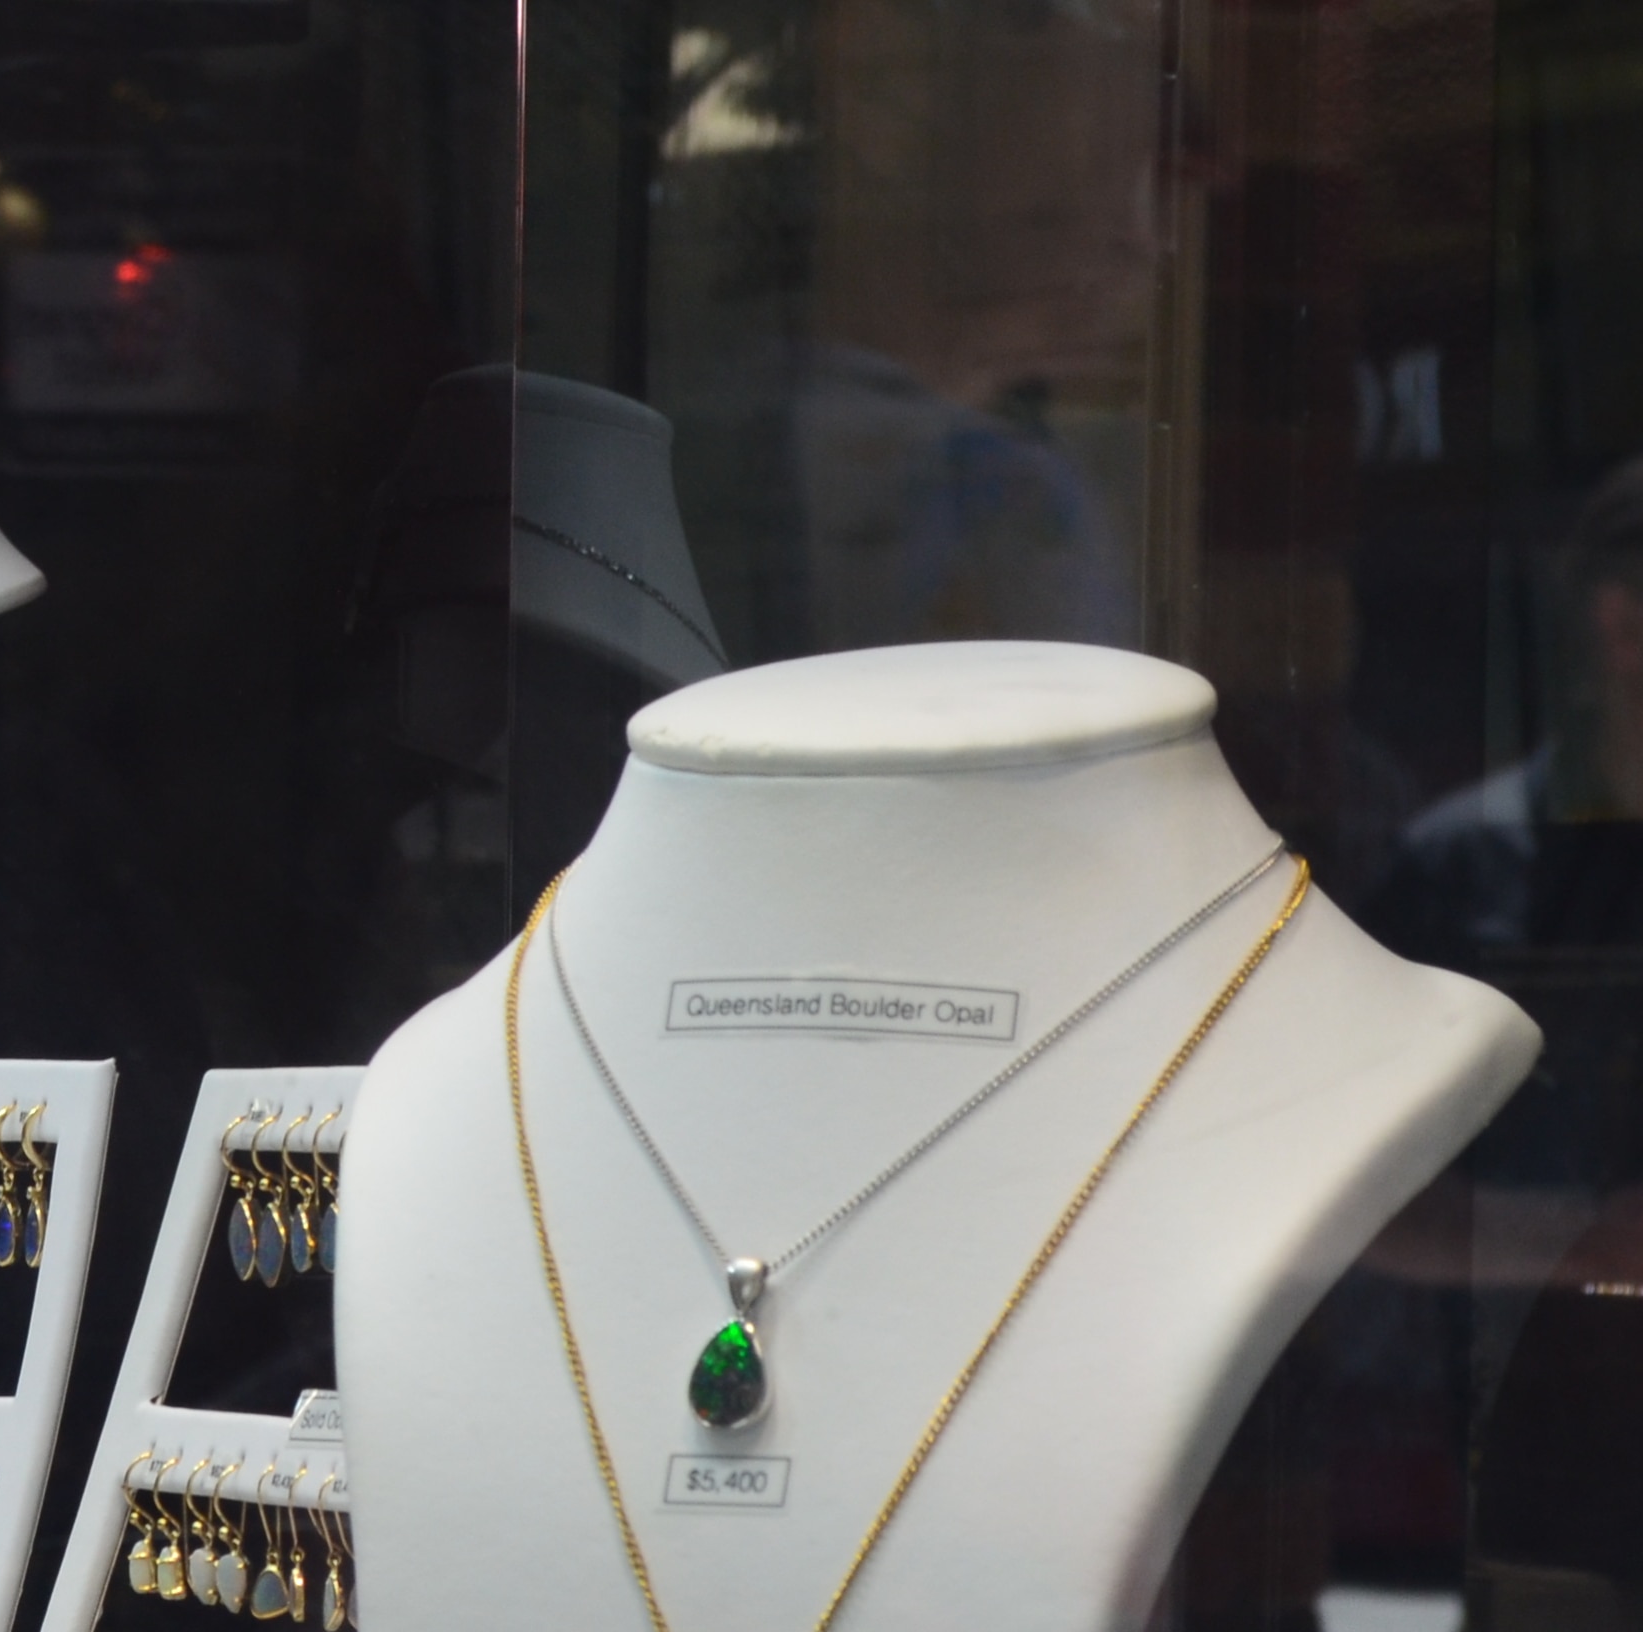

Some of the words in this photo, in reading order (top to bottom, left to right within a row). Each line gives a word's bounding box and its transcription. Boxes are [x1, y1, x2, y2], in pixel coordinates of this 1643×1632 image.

[686, 994, 820, 1017] Queensland
[830, 993, 925, 1021] Boulder
[934, 1000, 995, 1026] Opal
[687, 1467, 768, 1494] $5,400
